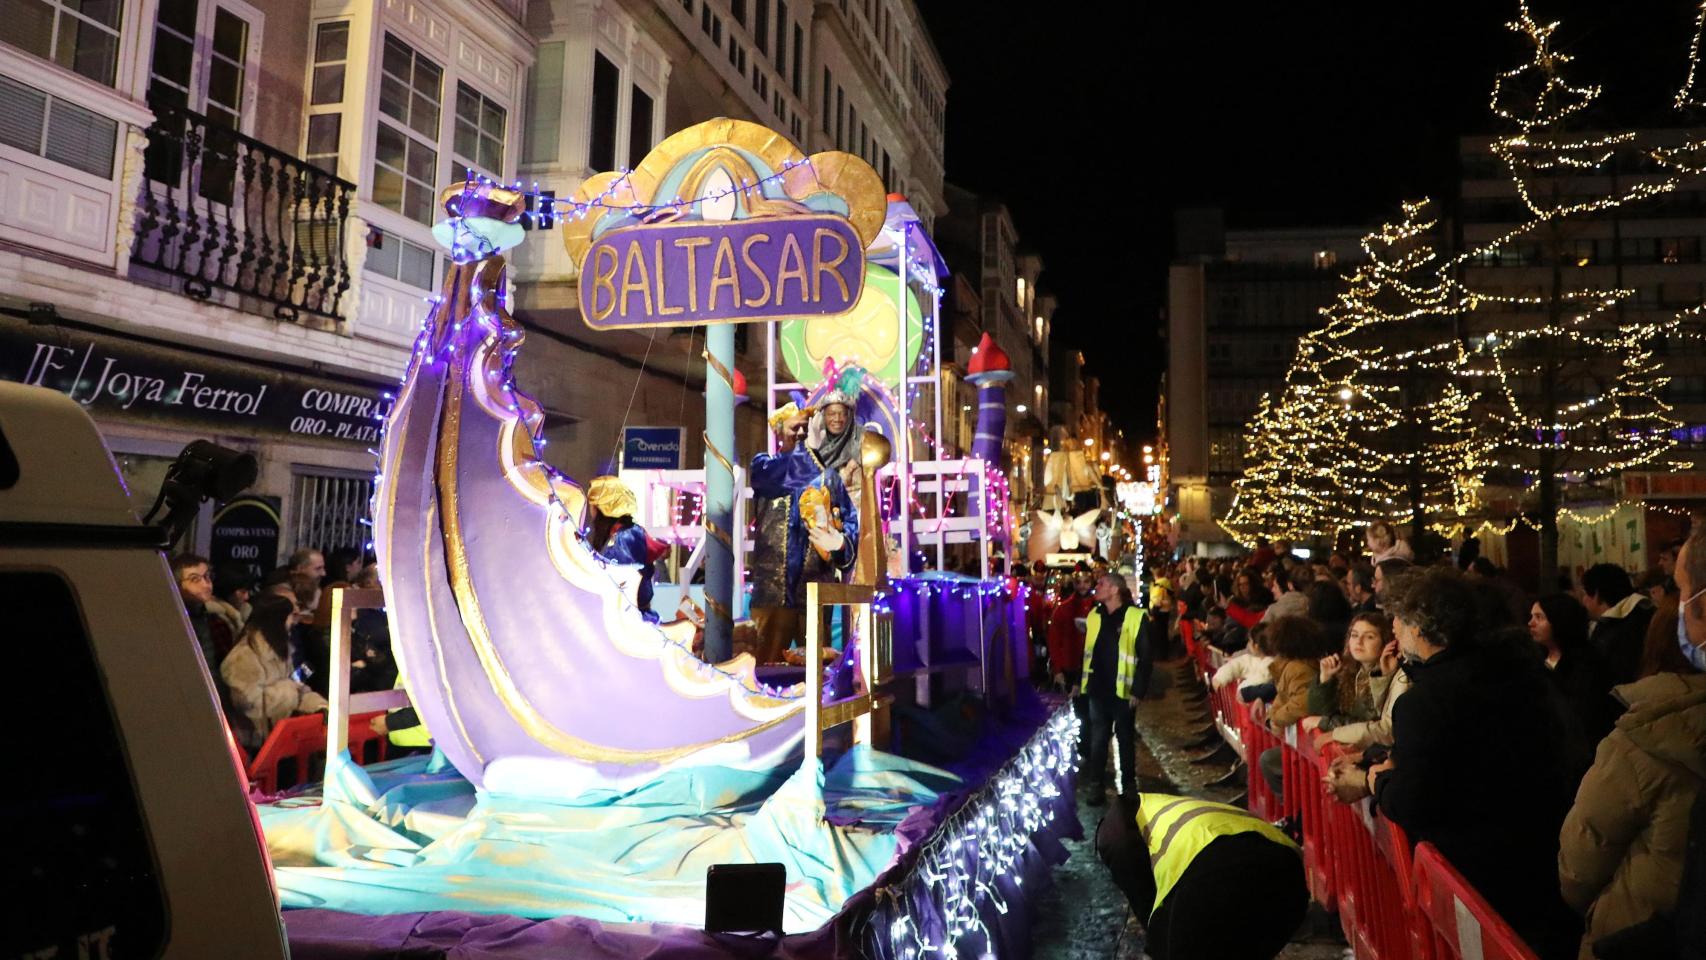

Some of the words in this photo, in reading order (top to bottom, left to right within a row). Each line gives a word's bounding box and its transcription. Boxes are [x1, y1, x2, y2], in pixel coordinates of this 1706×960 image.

[591, 228, 849, 320] BALTASAR
[81, 357, 165, 409] Joya
[172, 372, 267, 415] Ferrol
[301, 388, 380, 418] COMPRA
[290, 416, 326, 435] ORO
[334, 422, 378, 441] PLATA
[216, 527, 250, 537] COMPRA
[251, 527, 276, 537] VENTA
[231, 544, 259, 559] ORO
